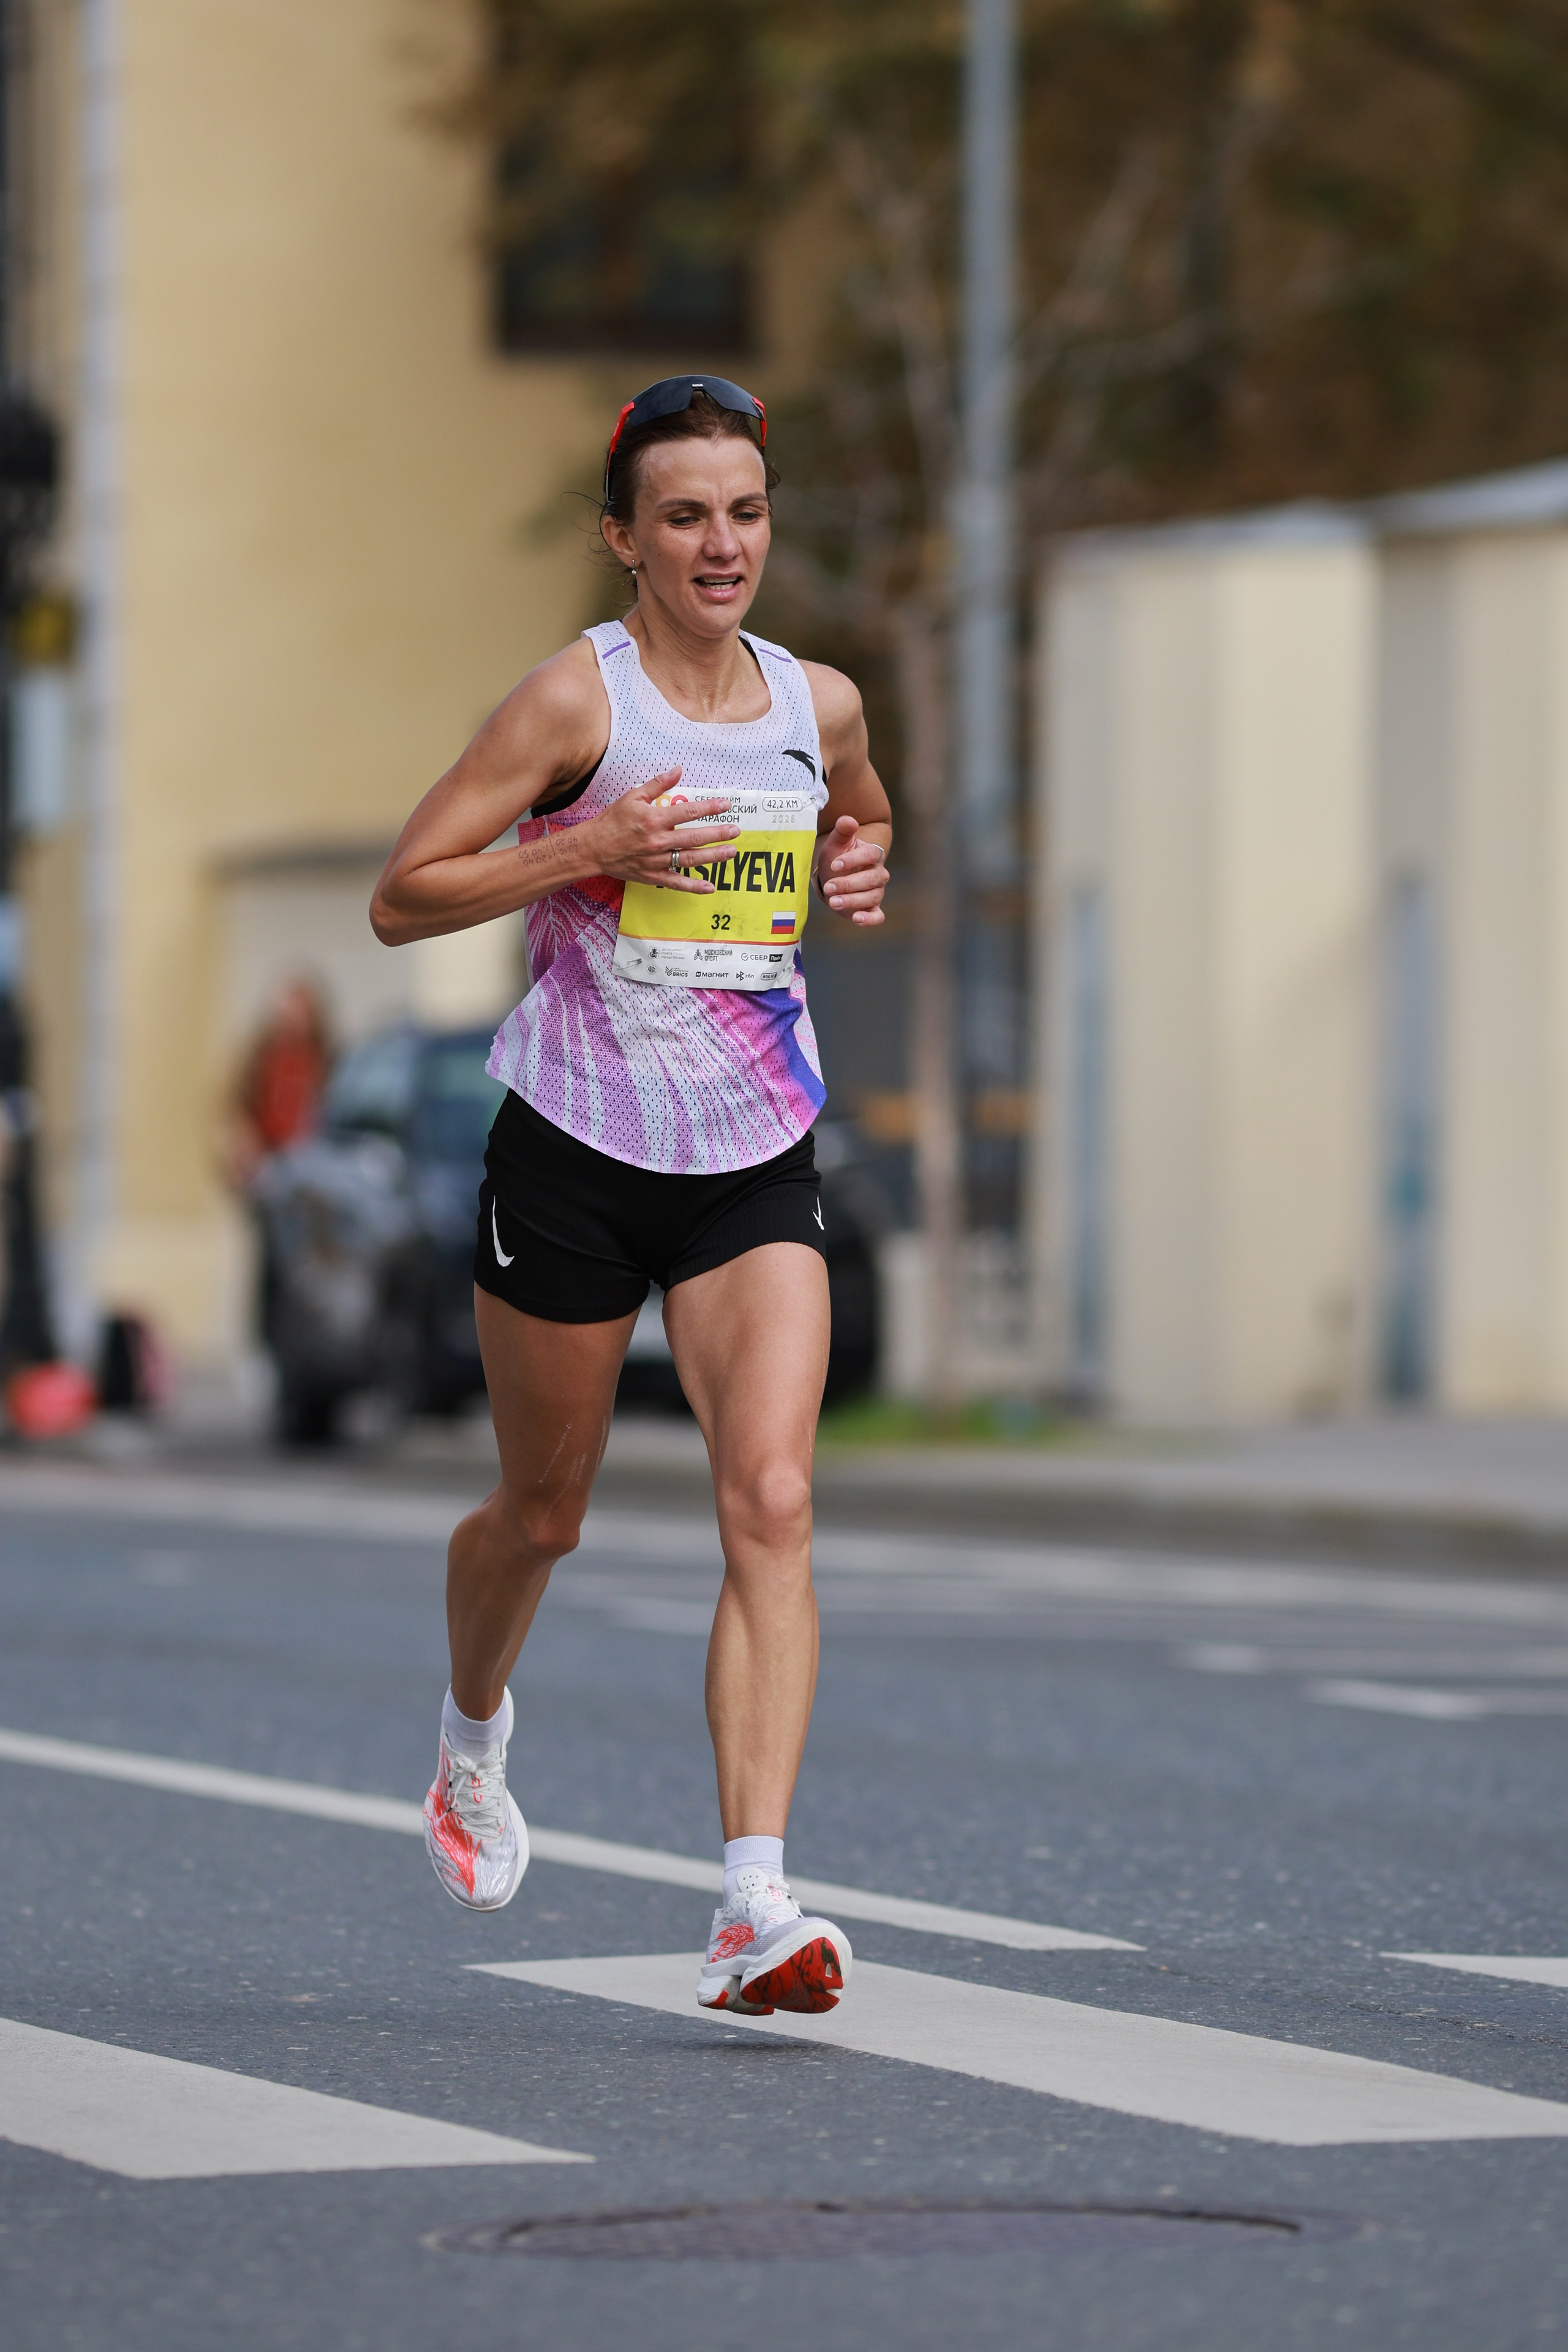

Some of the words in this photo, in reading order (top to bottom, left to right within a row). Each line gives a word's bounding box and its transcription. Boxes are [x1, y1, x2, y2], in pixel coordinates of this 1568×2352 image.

[767, 800, 783, 809] 42,2
[772, 815, 795, 823] 2026
[655, 851, 795, 893] ILYEVA
[710, 914, 731, 930] 32
